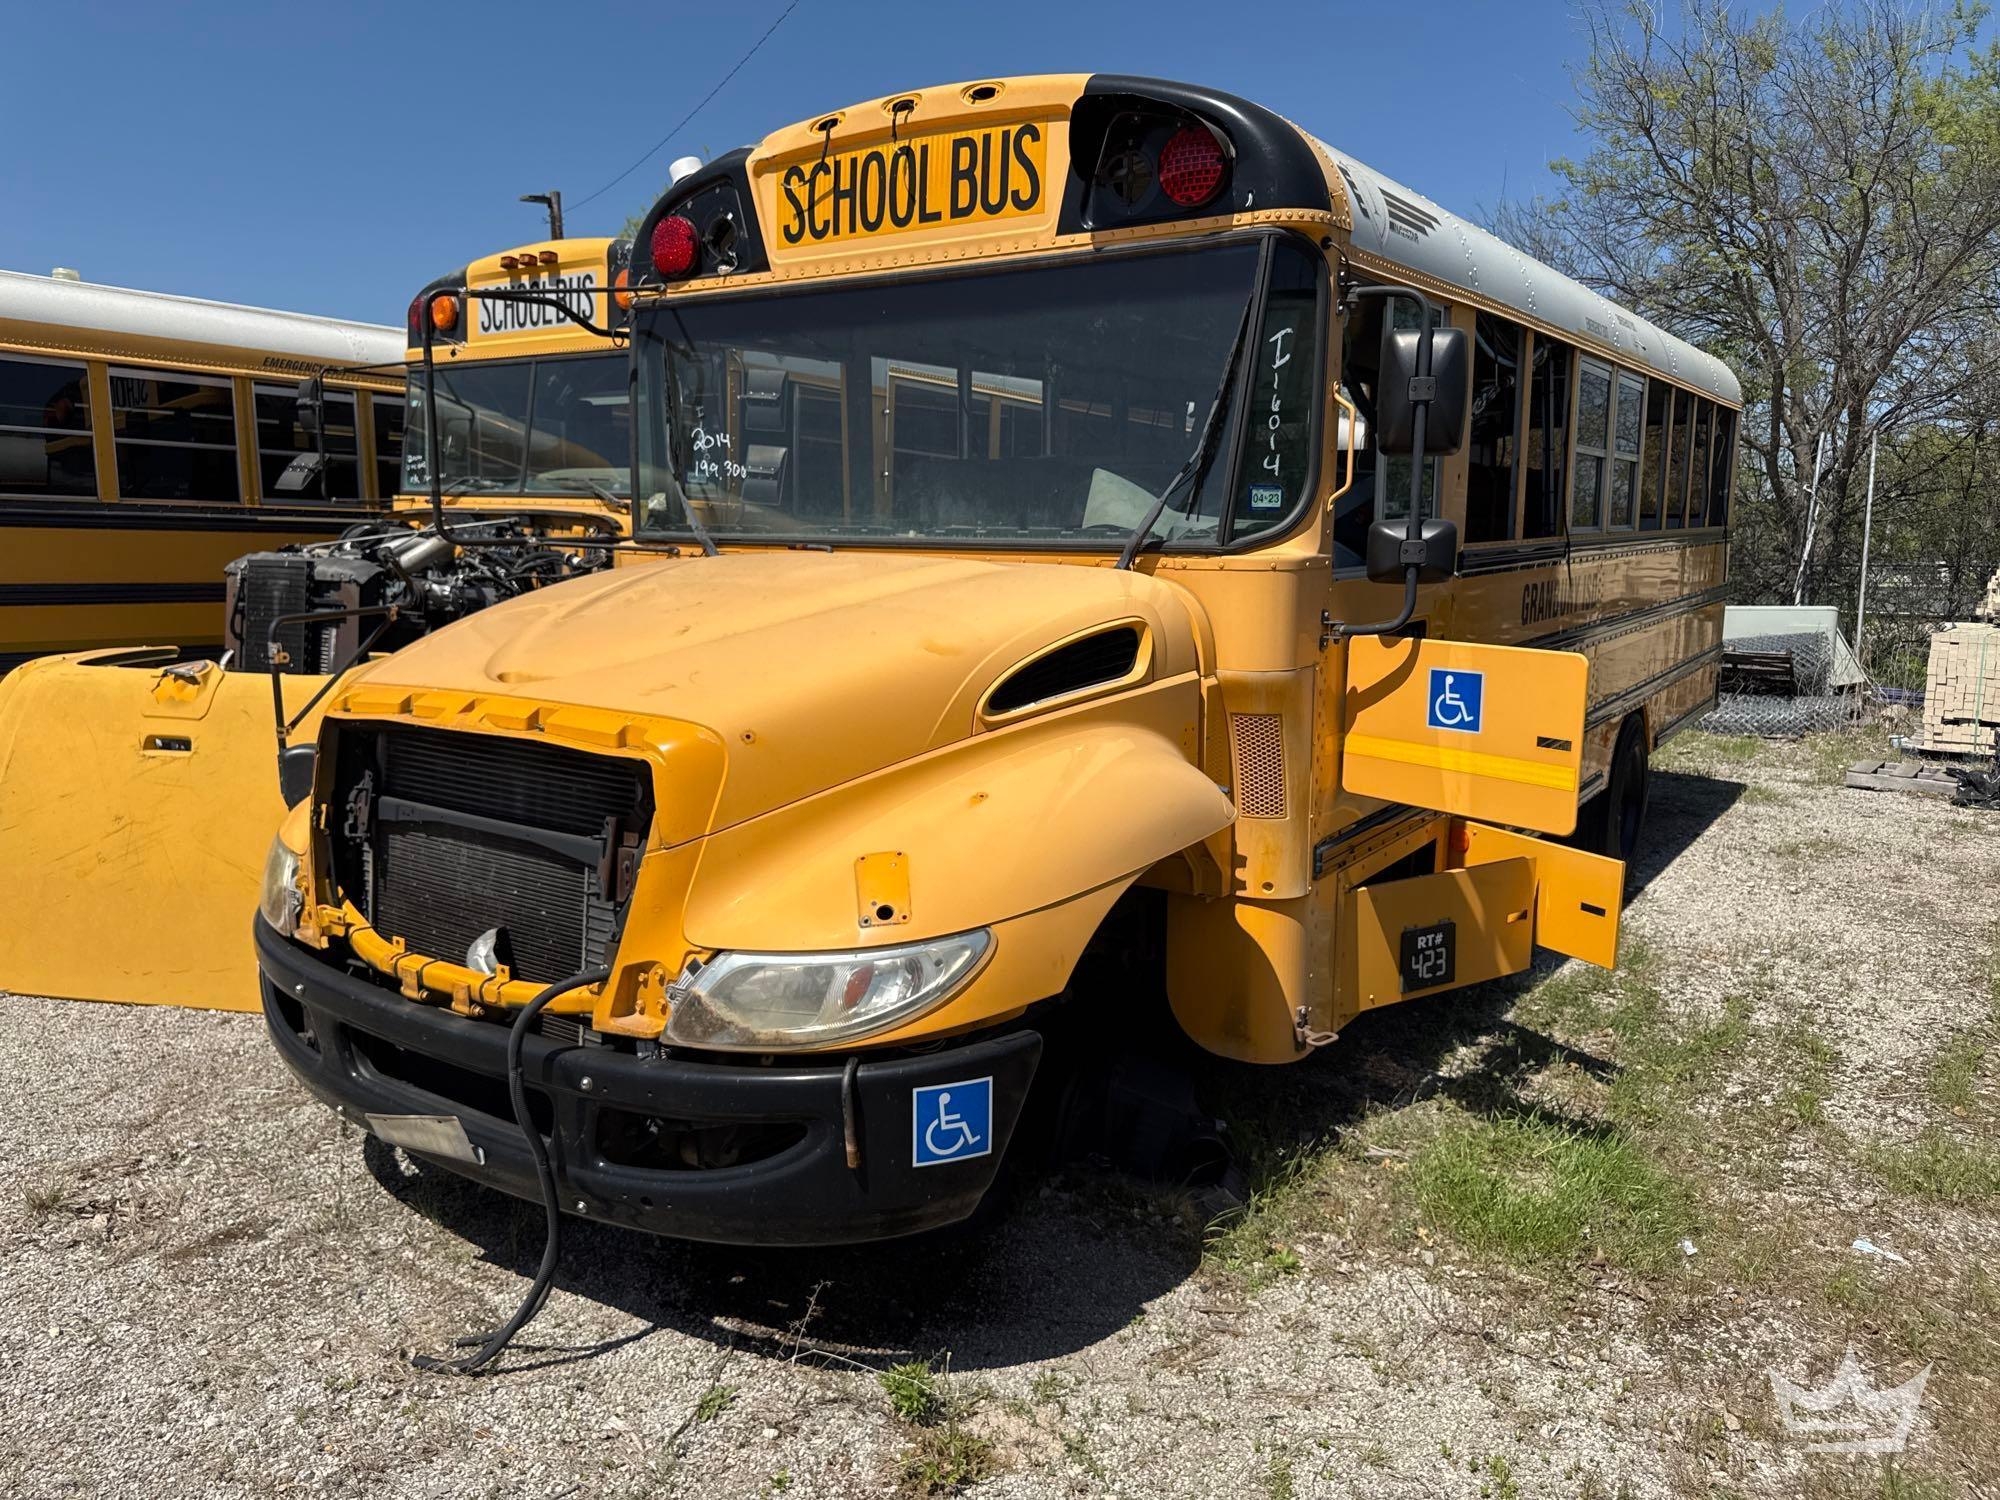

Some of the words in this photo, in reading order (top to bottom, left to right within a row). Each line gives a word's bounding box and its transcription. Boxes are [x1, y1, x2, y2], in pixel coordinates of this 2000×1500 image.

[782, 144, 942, 244] SCHOOL
[950, 123, 1041, 220] BUS
[480, 280, 553, 333] SCHOOL
[556, 273, 594, 323] BUS
[691, 428, 731, 451] 2014
[1417, 932, 1444, 949] RT#
[1411, 947, 1447, 978] 423
